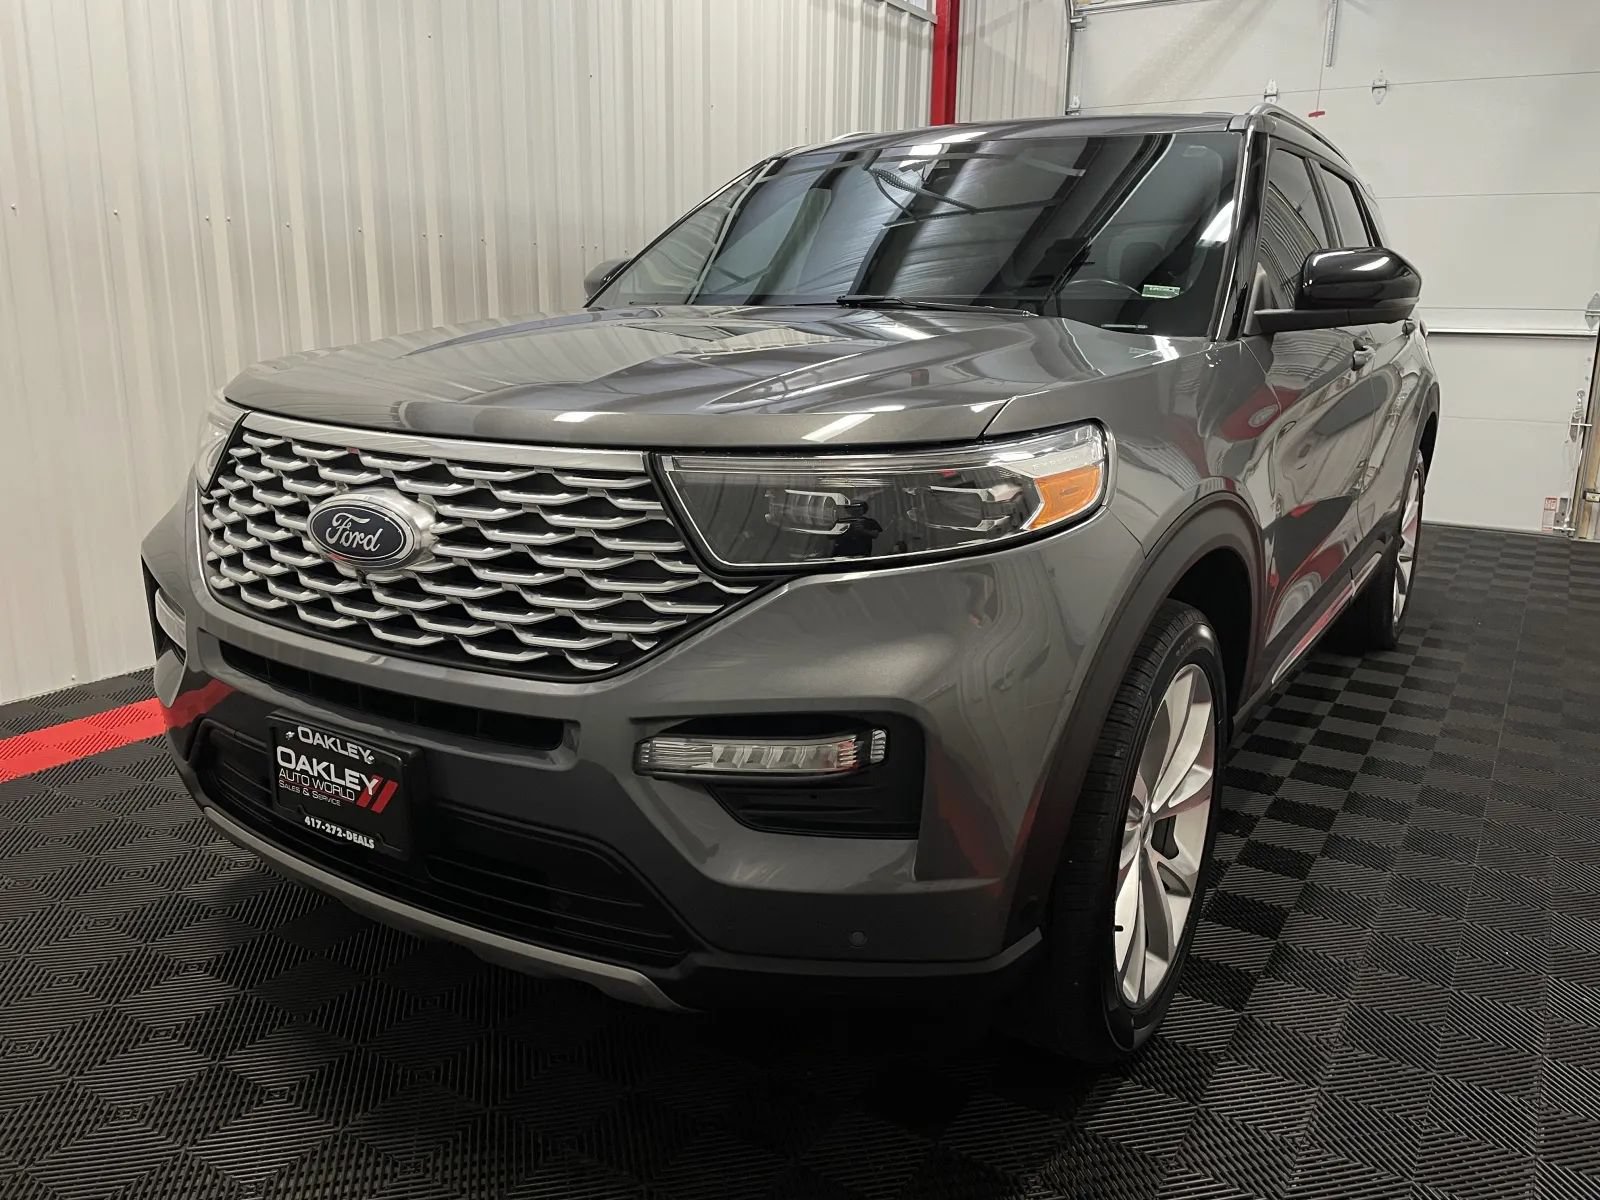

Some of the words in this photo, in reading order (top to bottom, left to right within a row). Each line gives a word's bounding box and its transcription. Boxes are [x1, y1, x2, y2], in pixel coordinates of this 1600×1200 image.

[326, 512, 383, 551] Ford
[298, 726, 374, 762] OAKLEY
[276, 746, 379, 795] OAKLEY
[278, 768, 310, 786] AUTO
[312, 777, 355, 801] WORLD
[278, 779, 301, 794] SALES
[302, 787, 310, 796] &
[304, 816, 375, 849] 417-272-DEALS
